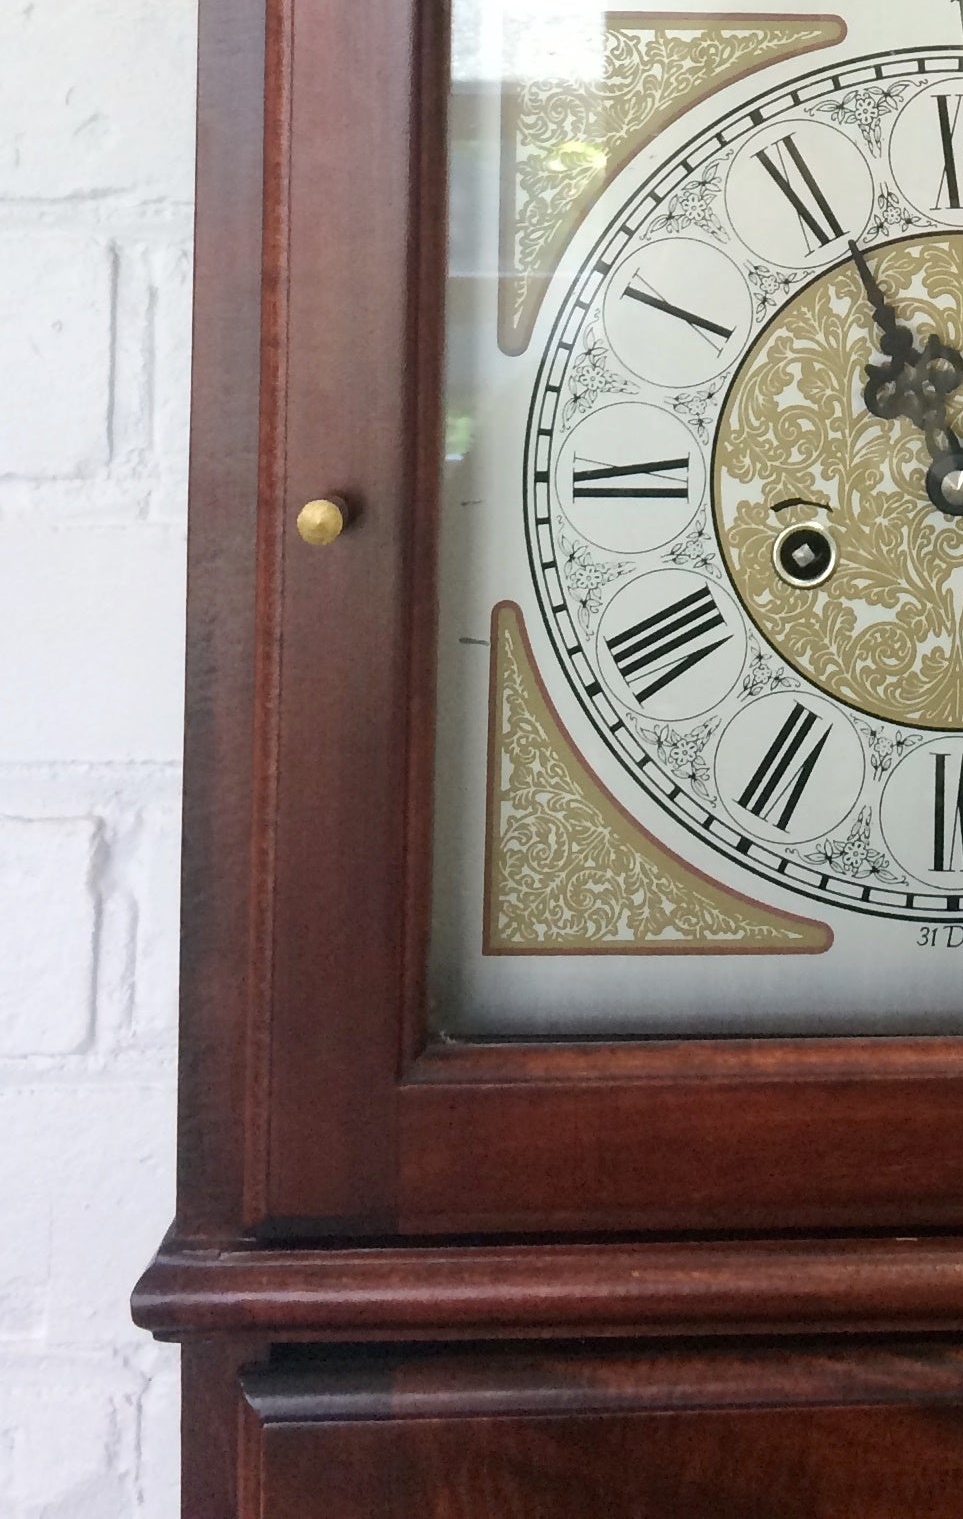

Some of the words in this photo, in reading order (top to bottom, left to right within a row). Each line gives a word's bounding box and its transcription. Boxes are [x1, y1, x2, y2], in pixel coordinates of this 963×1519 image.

[754, 134, 848, 257] XI
[621, 267, 736, 358] X
[572, 449, 691, 505] IX
[603, 585, 736, 705] VIII
[735, 699, 835, 830] VII
[916, 926, 938, 948] 31
